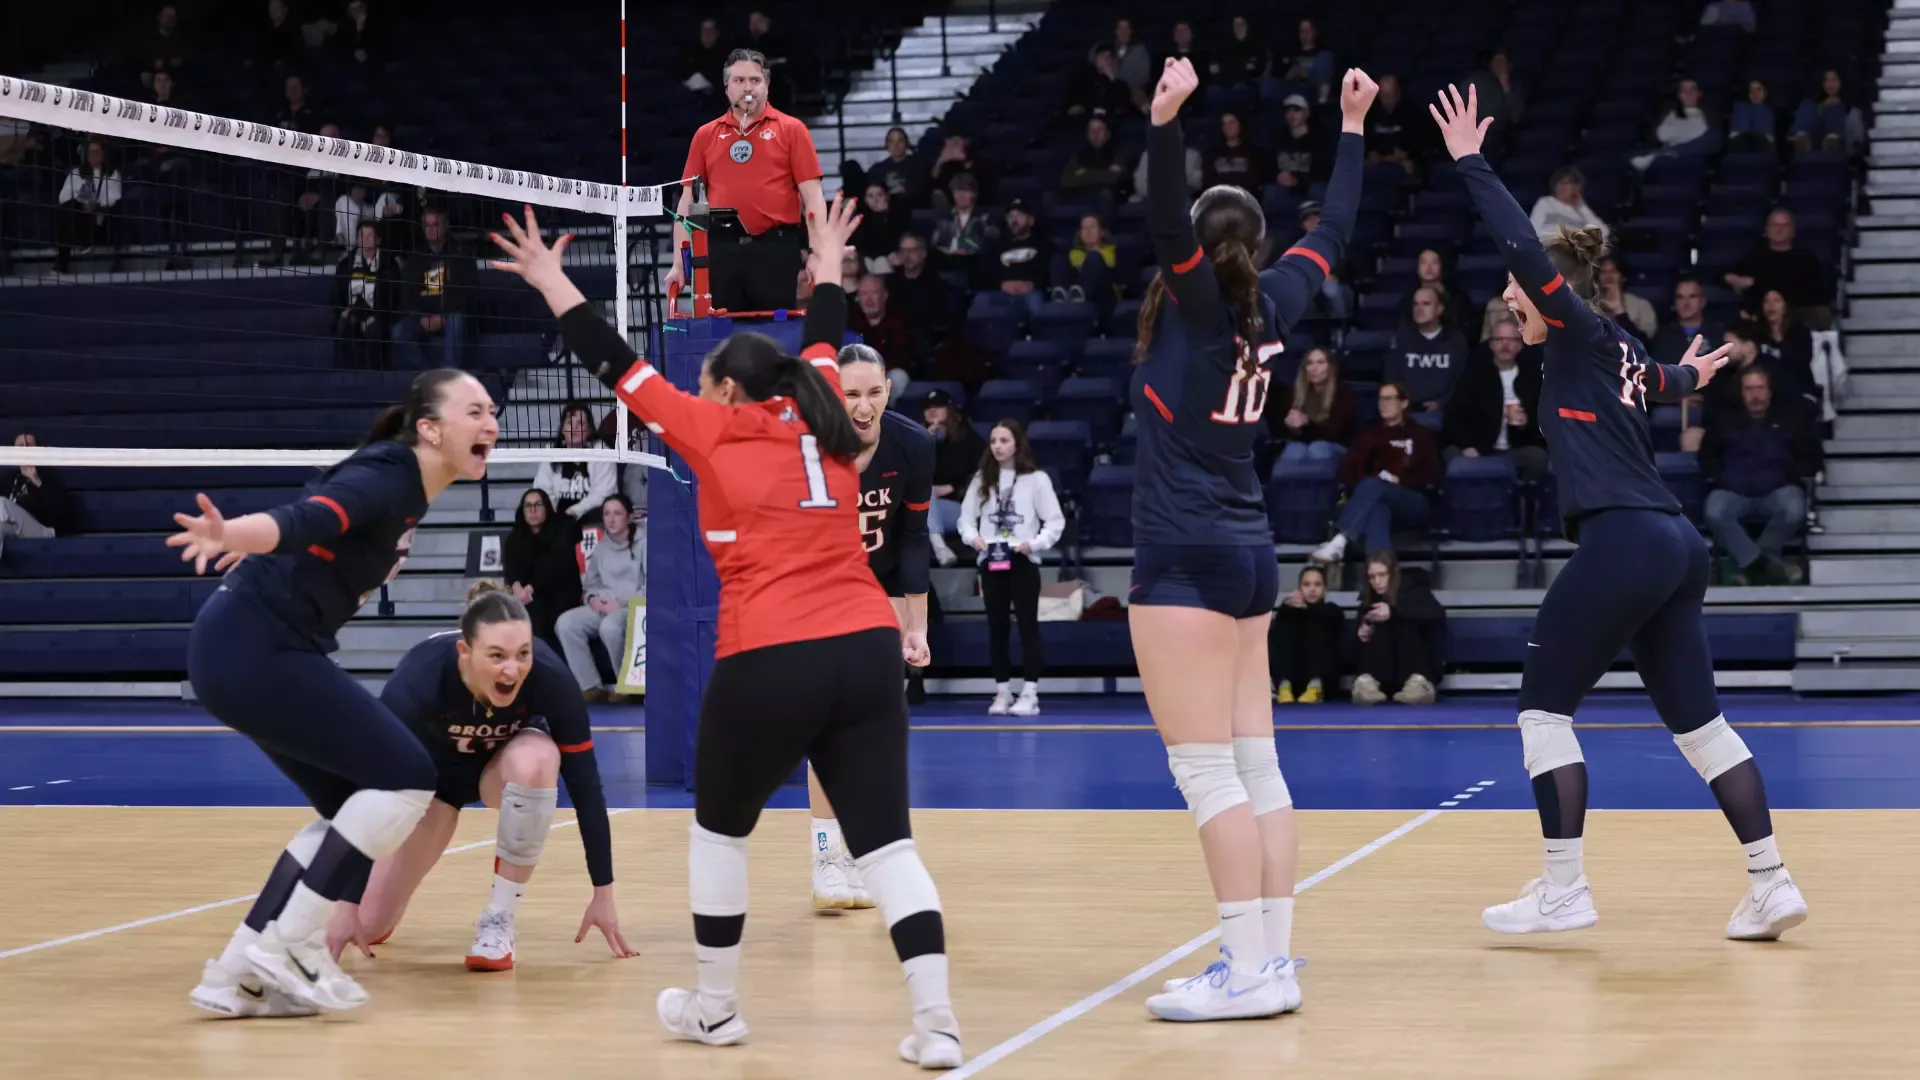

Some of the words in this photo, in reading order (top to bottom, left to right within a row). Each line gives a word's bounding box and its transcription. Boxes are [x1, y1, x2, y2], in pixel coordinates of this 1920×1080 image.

[1405, 353, 1450, 368] TWU
[798, 433, 838, 509] 1
[856, 487, 892, 508] OCK
[447, 719, 522, 737] BROCK
